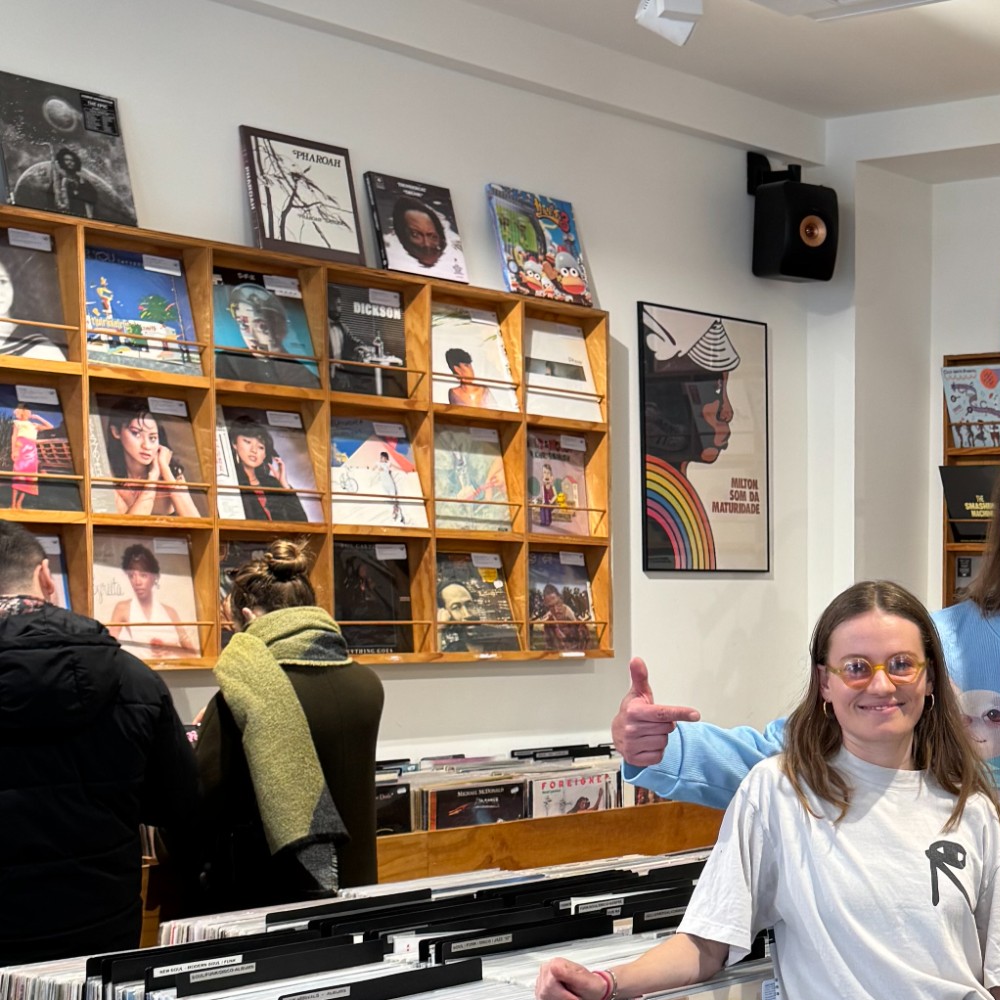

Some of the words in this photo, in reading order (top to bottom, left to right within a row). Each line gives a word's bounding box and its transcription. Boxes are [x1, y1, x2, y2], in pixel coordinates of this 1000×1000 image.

[292, 149, 341, 168] PHAROAH
[353, 301, 401, 320] DICKSON
[731, 477, 758, 490] MILTON
[730, 490, 747, 502] SOM
[749, 491, 760, 502] DA
[712, 501, 760, 515] MATURIDADE
